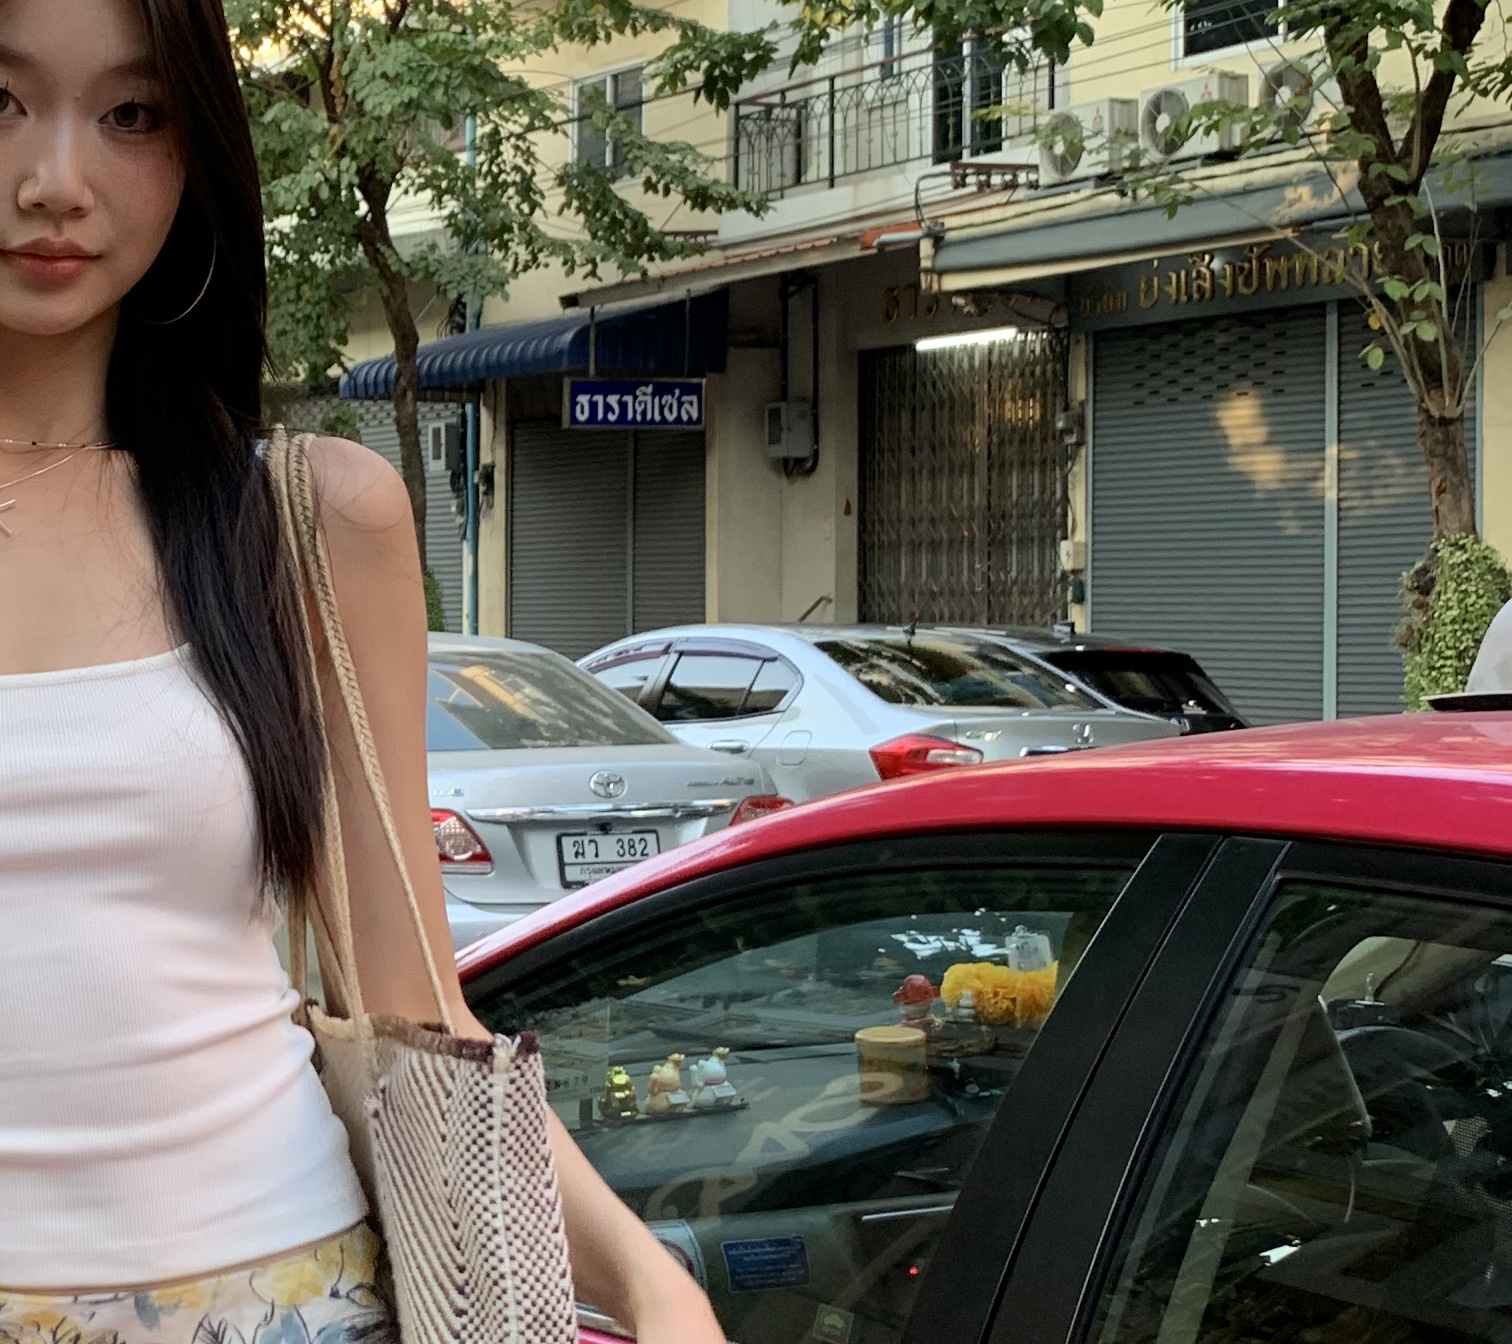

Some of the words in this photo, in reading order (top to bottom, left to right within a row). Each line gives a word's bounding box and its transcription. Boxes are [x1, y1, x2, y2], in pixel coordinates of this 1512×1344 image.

[575, 383, 699, 422] ธาราดีเซล
[616, 837, 649, 858] 382
